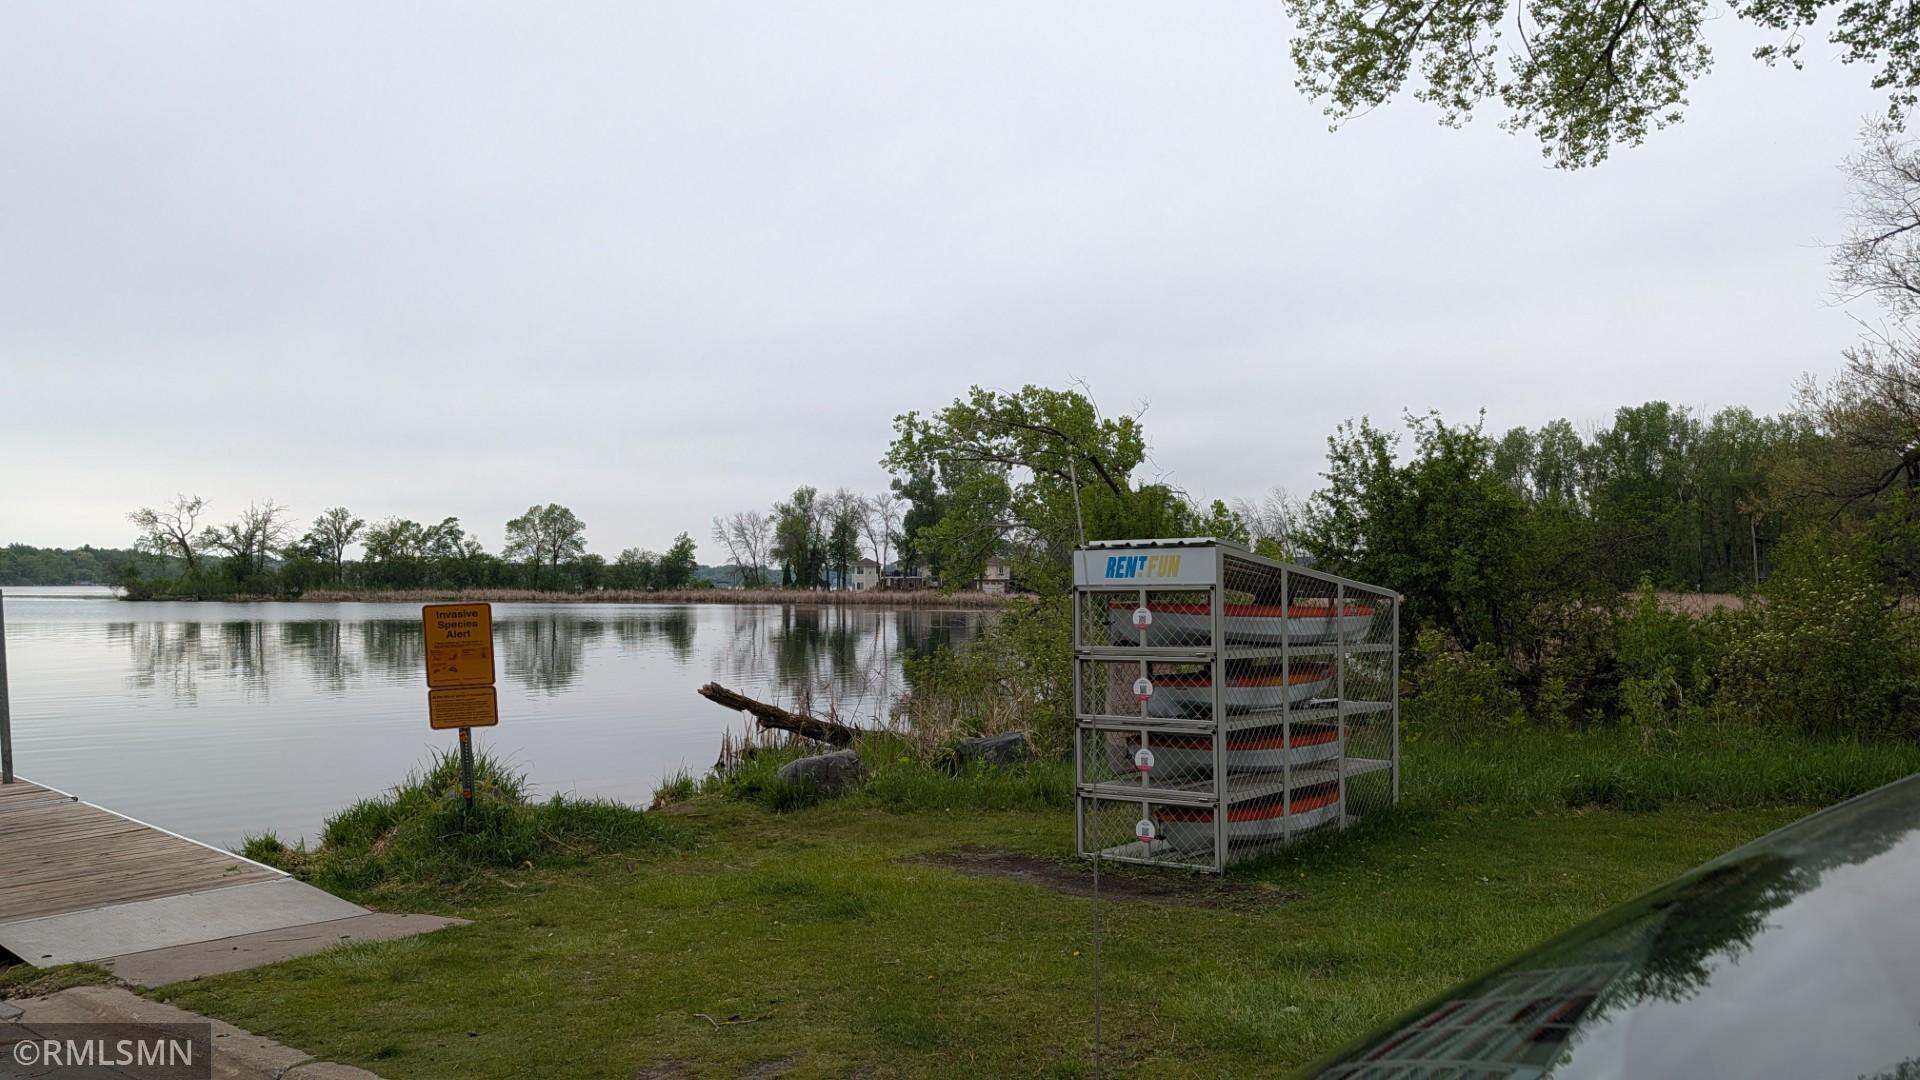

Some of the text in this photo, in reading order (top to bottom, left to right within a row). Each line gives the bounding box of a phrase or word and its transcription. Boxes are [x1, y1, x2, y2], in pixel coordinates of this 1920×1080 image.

[436, 609, 478, 619] Invasive
[437, 620, 478, 630] Species
[446, 630, 471, 639] Alert
